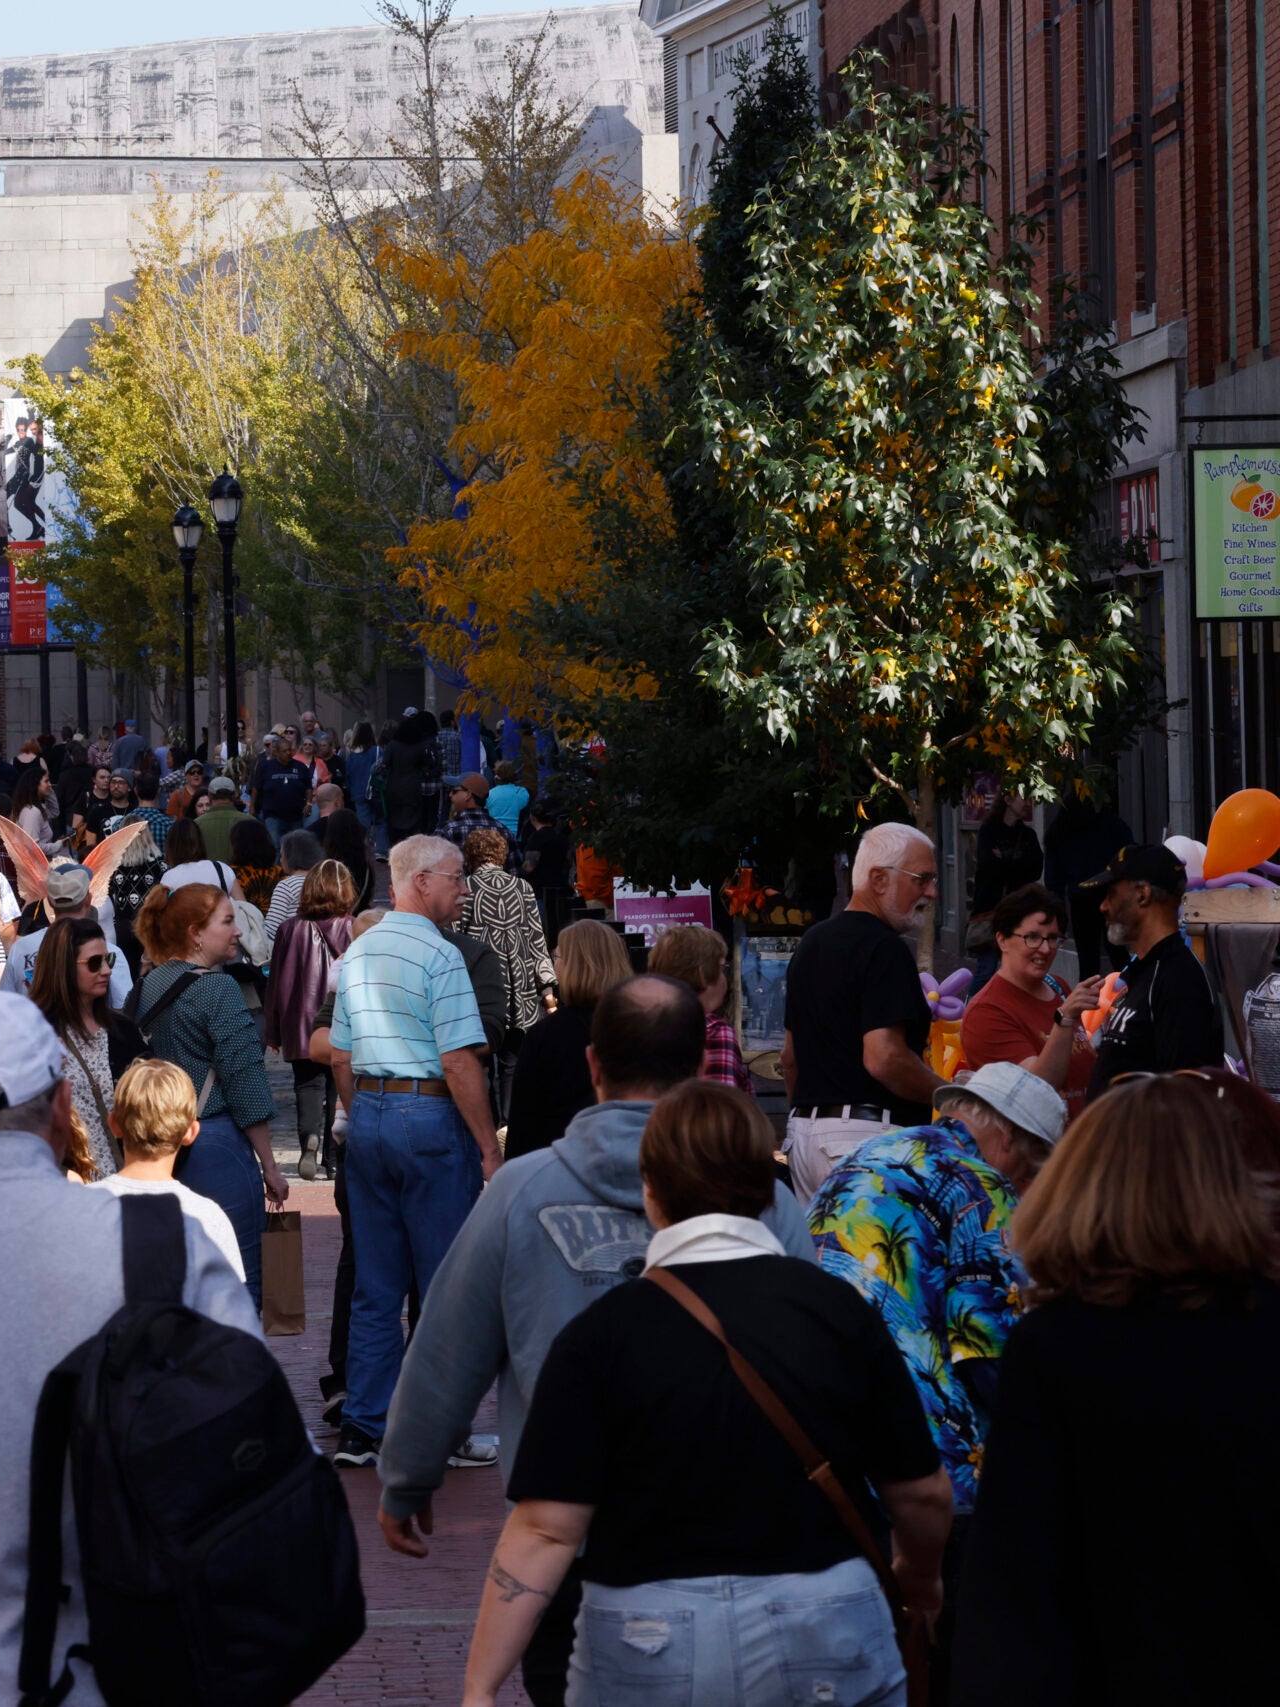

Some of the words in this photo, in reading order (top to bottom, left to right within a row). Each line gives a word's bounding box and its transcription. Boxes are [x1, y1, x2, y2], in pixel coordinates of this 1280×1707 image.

[714, 45, 734, 79] EAST
[1232, 523, 1268, 533] Kitchen
[1224, 539, 1245, 549] Fine
[1247, 539, 1277, 549] Wines
[1224, 555, 1250, 565] Craft
[1253, 555, 1277, 565] Beer
[1229, 571, 1272, 581] Gourmet
[1220, 587, 1246, 597] Home
[1238, 602, 1263, 612] Gifts
